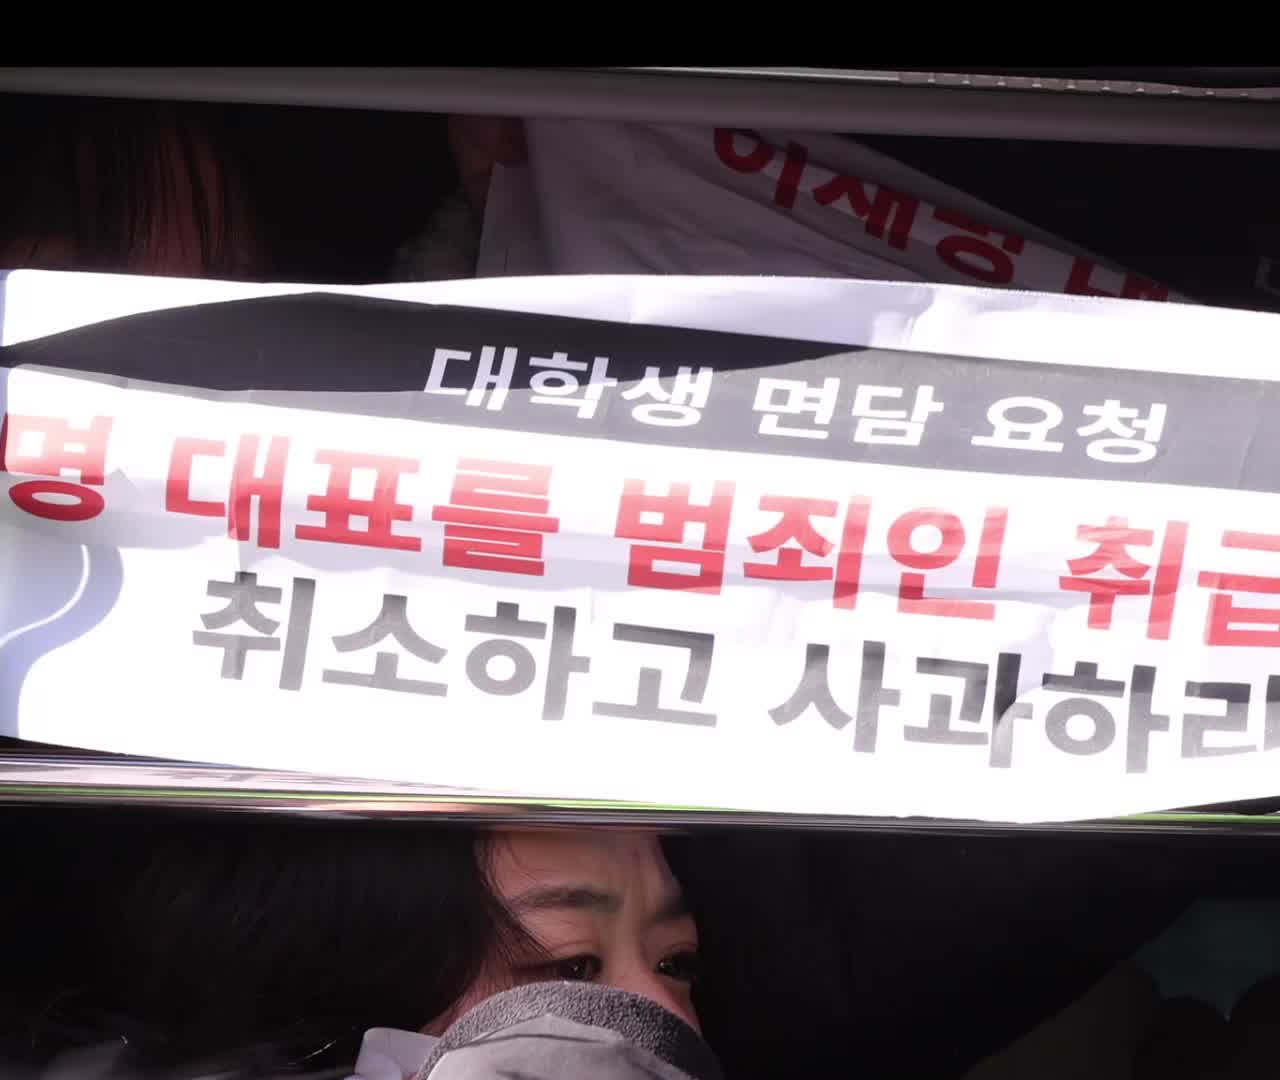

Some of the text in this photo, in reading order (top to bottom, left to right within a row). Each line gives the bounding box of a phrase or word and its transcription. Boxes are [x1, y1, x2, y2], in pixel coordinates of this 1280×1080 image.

[424, 345, 1168, 465] 대학생 면담 요청
[164, 433, 561, 577] 대표를
[613, 478, 1010, 621] 범죄인
[191, 570, 719, 728] 취소하고
